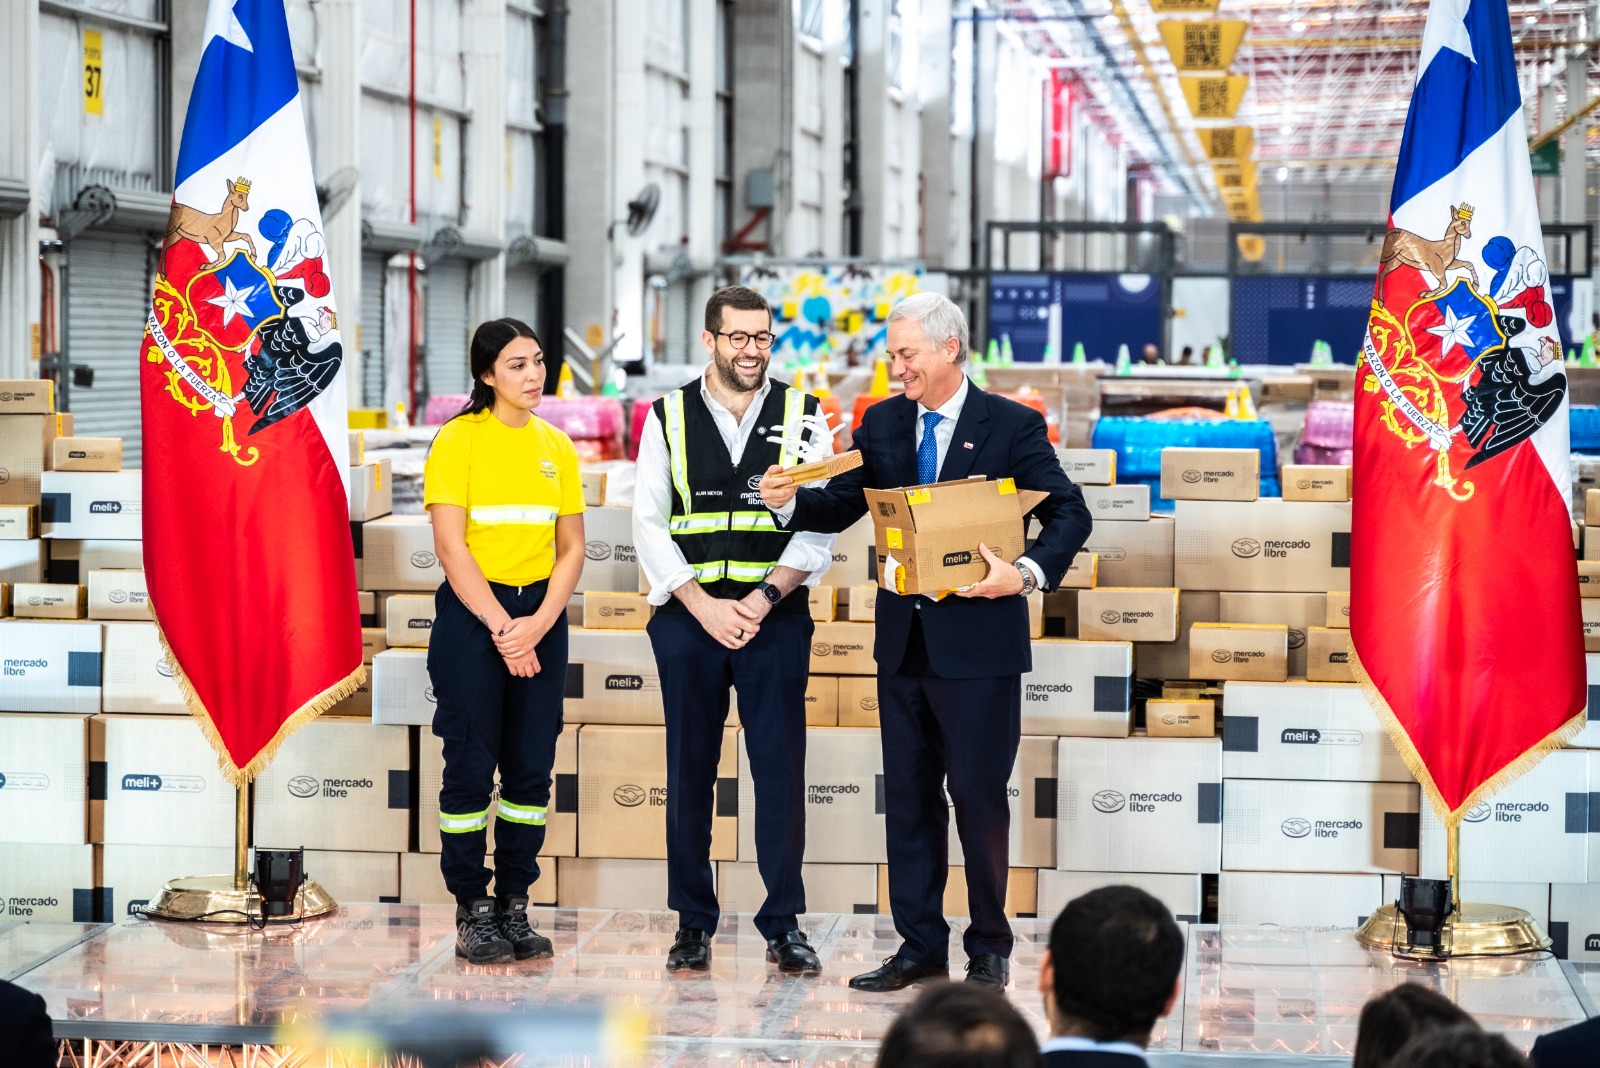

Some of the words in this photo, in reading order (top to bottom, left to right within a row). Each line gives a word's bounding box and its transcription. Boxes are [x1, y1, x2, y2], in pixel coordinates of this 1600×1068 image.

[86, 65, 101, 98] 37
[149, 316, 169, 349] RAZON
[174, 359, 186, 372] LA
[186, 372, 216, 402] FUERZA
[1366, 344, 1386, 378] RAZON
[1390, 388, 1402, 403] LA
[1402, 402, 1432, 433] FUERZA
[92, 502, 119, 512] meli+
[1264, 540, 1310, 549] mercado
[614, 552, 636, 562] libre
[1264, 549, 1287, 558] libre
[945, 554, 970, 564] meli+
[4, 658, 48, 667] mercado
[4, 667, 25, 675] libre
[608, 677, 640, 687] meli+
[1026, 684, 1072, 692] mercado
[1026, 692, 1049, 701] libre
[1284, 731, 1318, 742] meli+
[125, 777, 159, 788] meli+
[323, 778, 373, 788] mercado
[323, 788, 348, 797] libre
[808, 784, 860, 793] mercado
[650, 797, 667, 806] libr
[808, 794, 833, 804] libre
[1130, 792, 1182, 802] mercado
[1130, 802, 1155, 812] libre
[1495, 802, 1549, 812] mercado
[1495, 812, 1522, 822] libre
[1315, 819, 1362, 829] mercado
[1315, 829, 1338, 837] libre
[9, 897, 58, 906] mercado
[9, 906, 33, 916] libre
